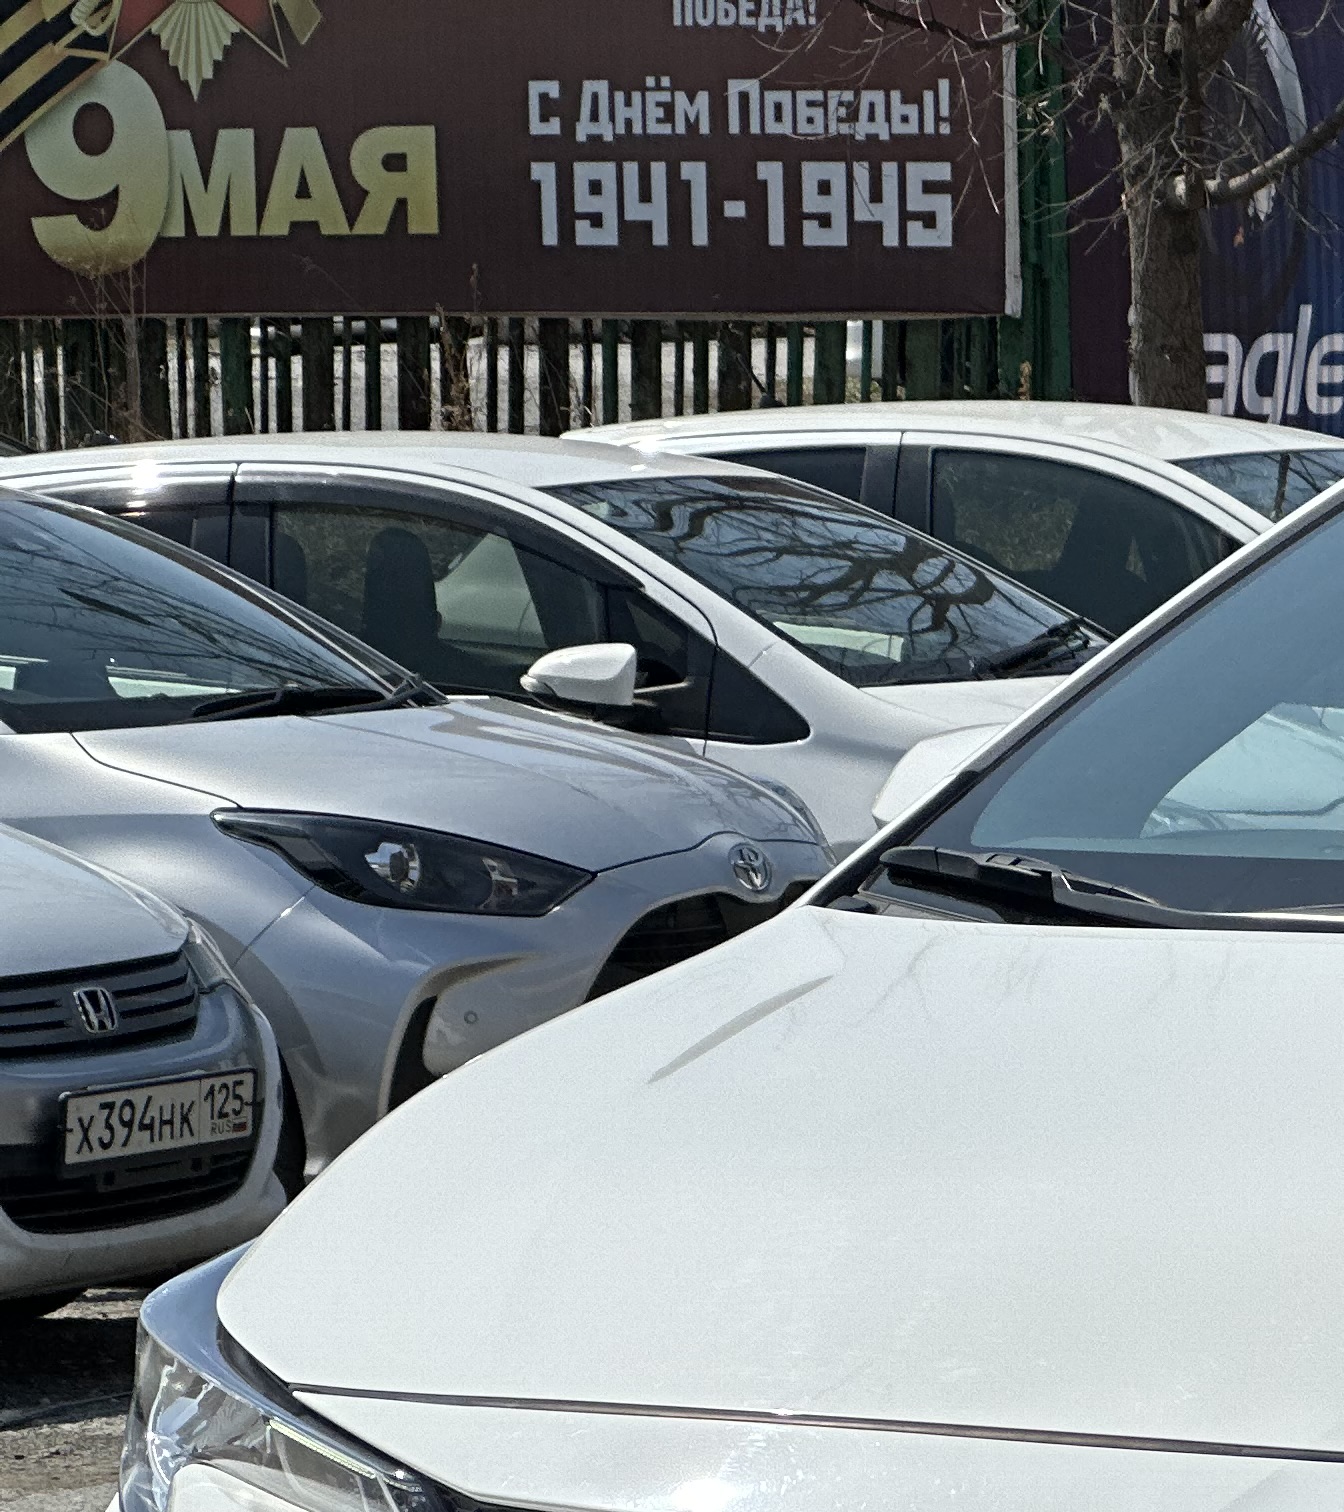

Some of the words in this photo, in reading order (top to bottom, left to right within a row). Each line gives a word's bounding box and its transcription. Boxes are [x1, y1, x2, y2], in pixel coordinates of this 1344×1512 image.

[529, 80, 558, 136] С
[530, 161, 953, 248] 1941-1945
[204, 1079, 245, 1120] 125
[210, 1121, 233, 1137] RUS
